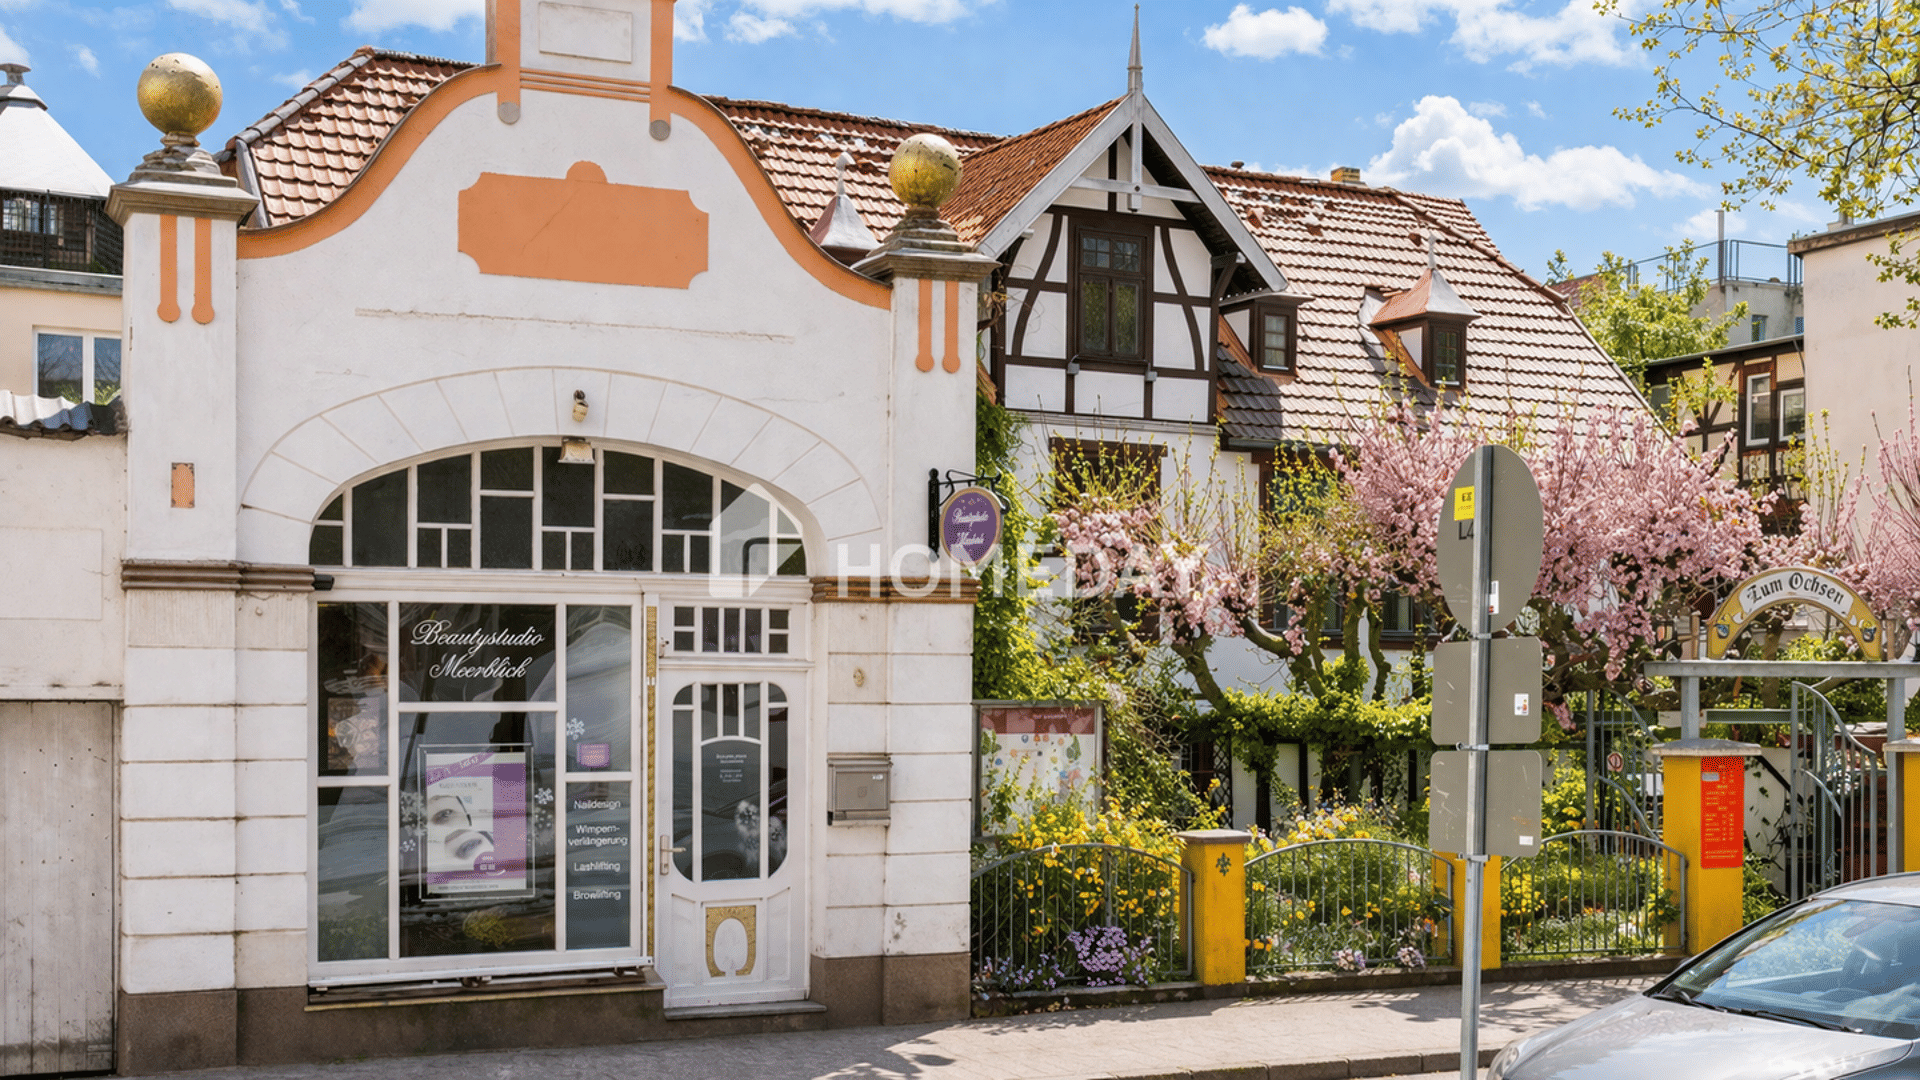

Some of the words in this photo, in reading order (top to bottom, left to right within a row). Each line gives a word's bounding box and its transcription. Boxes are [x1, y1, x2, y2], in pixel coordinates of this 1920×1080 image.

[1747, 579, 1783, 604] Zum
[1789, 572, 1844, 605] Ochsen
[410, 619, 545, 655] Beautystudio
[429, 653, 532, 679] Meerblick
[573, 800, 621, 810] Naildesign
[574, 861, 621, 872] Lashlifting
[573, 889, 621, 900] Browlifting
